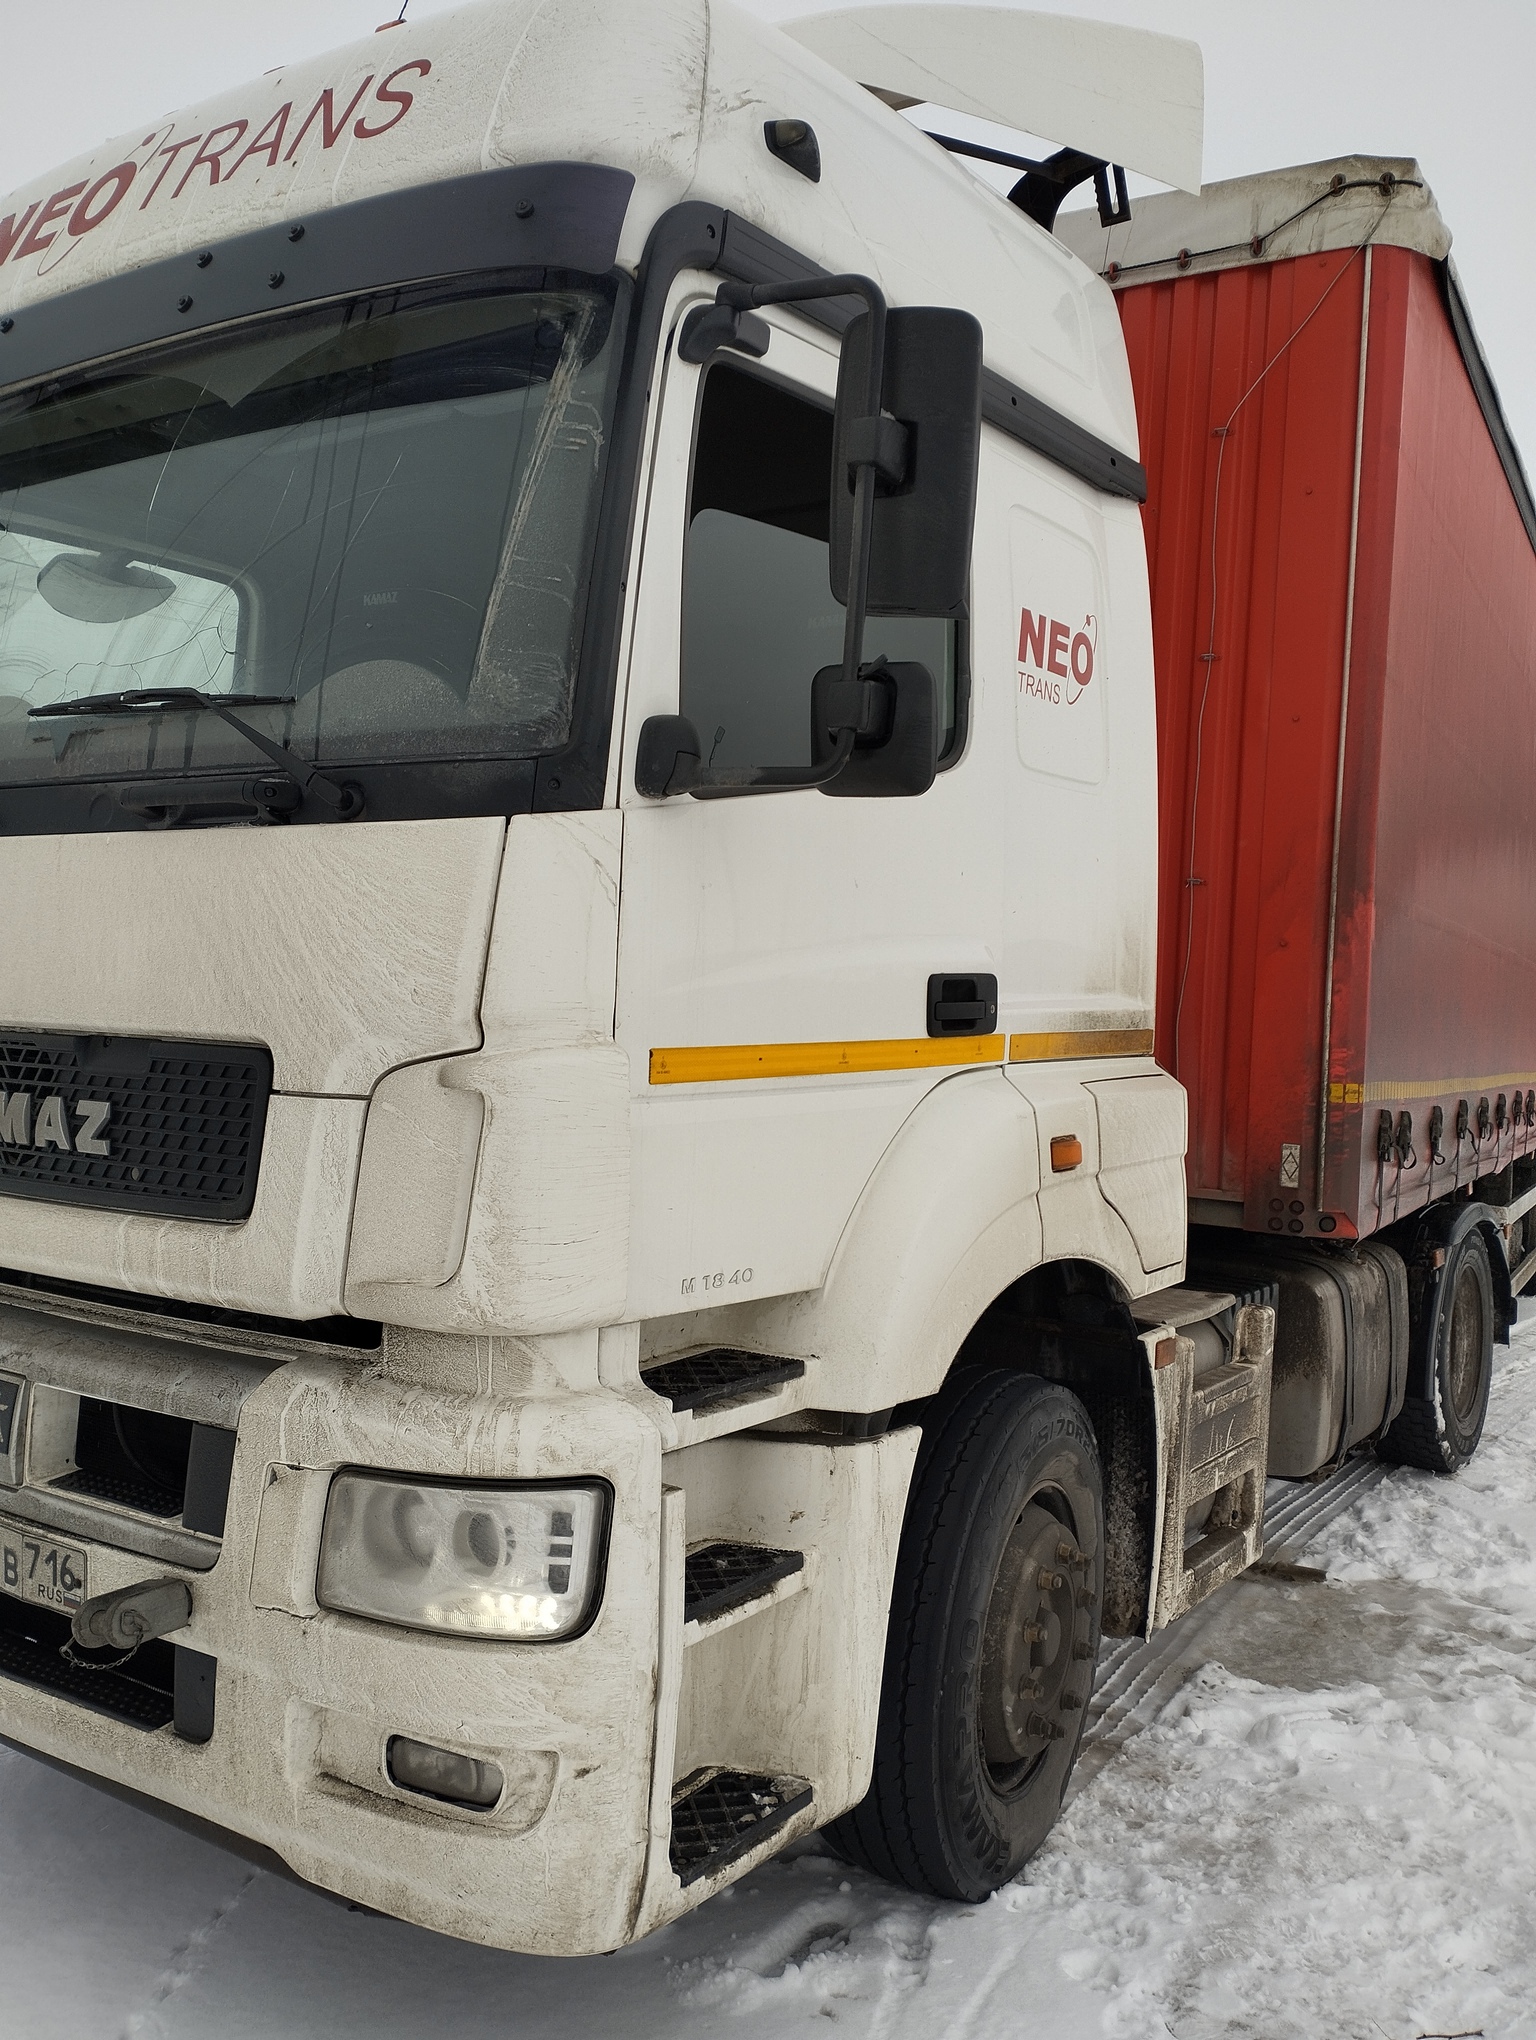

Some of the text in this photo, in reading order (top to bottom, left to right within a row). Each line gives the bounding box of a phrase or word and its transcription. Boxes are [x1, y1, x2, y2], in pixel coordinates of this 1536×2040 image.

[0, 58, 432, 266] NEO TRANS
[363, 591, 398, 606] KAMAZ
[1017, 607, 1094, 687] NEO
[1018, 671, 1061, 705] TRANS
[24, 1542, 76, 1591] 716
[38, 1583, 63, 1604] RUS
